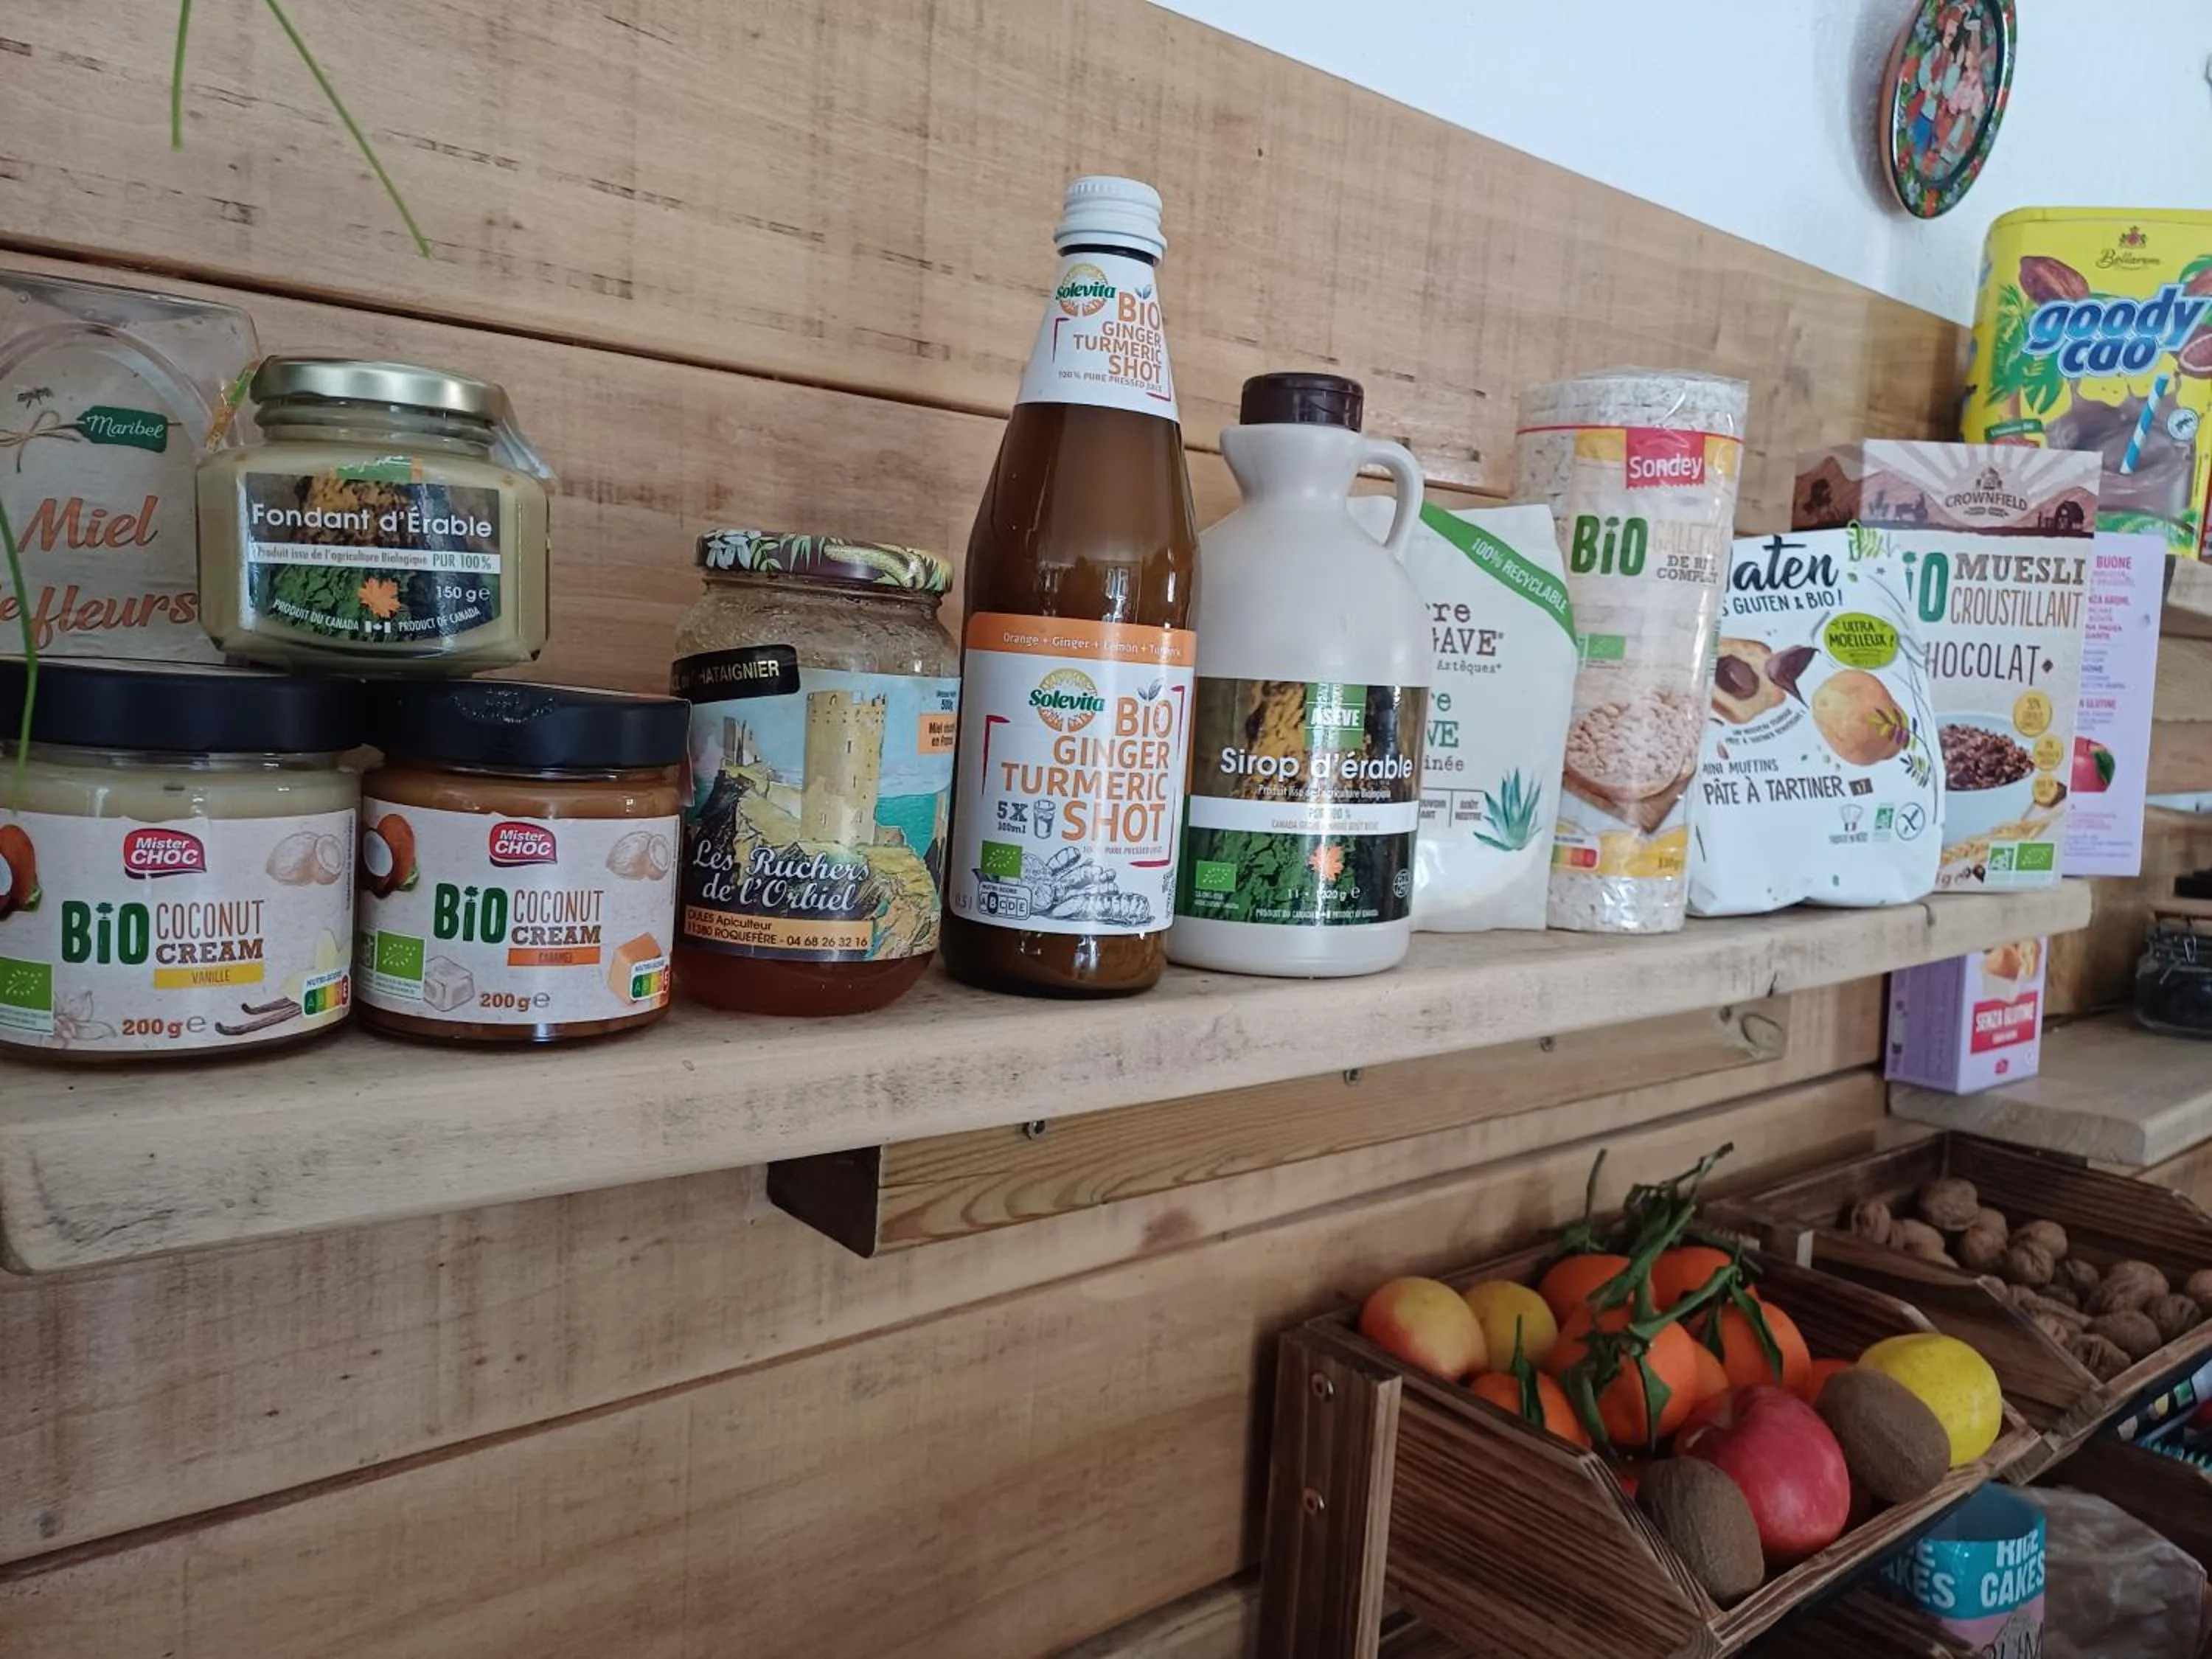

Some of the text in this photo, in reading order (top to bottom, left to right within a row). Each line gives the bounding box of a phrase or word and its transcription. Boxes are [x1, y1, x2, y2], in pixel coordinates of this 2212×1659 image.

[1056, 282, 1117, 299] Solevita
[2023, 285, 2208, 353] goody
[1074, 334, 1162, 364] TURMERIC
[1102, 321, 1161, 349] GINGER
[2059, 335, 2157, 375] cao
[1108, 355, 1162, 384] SHOT
[86, 414, 165, 439] Maribel
[1629, 453, 1703, 479] Sondey
[1945, 492, 2028, 512] CROWNFIELD
[17, 495, 159, 553] Miel
[251, 503, 493, 538] Fondant d'Érable
[433, 554, 456, 568] PUR
[1667, 554, 1717, 571] DE RI
[1727, 535, 1839, 593] aten
[1954, 553, 2086, 585] MUESLI
[2096, 555, 2132, 570] BUONE
[1472, 538, 1568, 615] 100% RECYCLABLE
[436, 585, 462, 599] 150
[1733, 594, 1790, 615] GLUTEN
[1794, 597, 1804, 609] &
[29, 585, 198, 650] fleurs
[273, 598, 481, 633] PRODUIT DU CANADA PRODUCT OF CANADA
[1950, 587, 2084, 628] CROUSTILLANT
[1003, 632, 1040, 646] Orange
[1052, 636, 1090, 649] Ginger
[1829, 633, 1887, 647] MOELLEUX
[1029, 689, 1105, 712] Solevita
[1054, 736, 1171, 770] GINGER
[1220, 746, 1414, 782] Sirop d'érable
[1728, 758, 1779, 775] MUFFINS
[1001, 762, 1169, 802] TURMERIC
[1703, 778, 1740, 805] PÂTE
[1745, 776, 1761, 804] À
[1765, 776, 1846, 802] TARTINER
[1061, 800, 1166, 843] SHOT
[136, 836, 189, 849] Mister
[494, 840, 553, 856] CHOC
[498, 830, 546, 842] Mister
[130, 848, 200, 866] CHOC
[693, 839, 871, 882] Les Ruchers
[702, 873, 857, 911] de l'Orbiel
[156, 900, 265, 940] COCONUT
[512, 889, 605, 924] COCONUT
[512, 925, 602, 946] CREAM
[714, 926, 777, 945] ROQUEFÈRE
[786, 936, 801, 947] 04
[804, 936, 818, 947] 68
[822, 936, 835, 947] 26
[838, 936, 852, 947] 32
[855, 936, 868, 947] 16
[716, 914, 773, 931] Apiculteur
[156, 938, 264, 965] CREAM
[191, 968, 231, 984] VANILLE
[1996, 1528, 2039, 1568] RICE
[1980, 1549, 2046, 1608] CAKES
